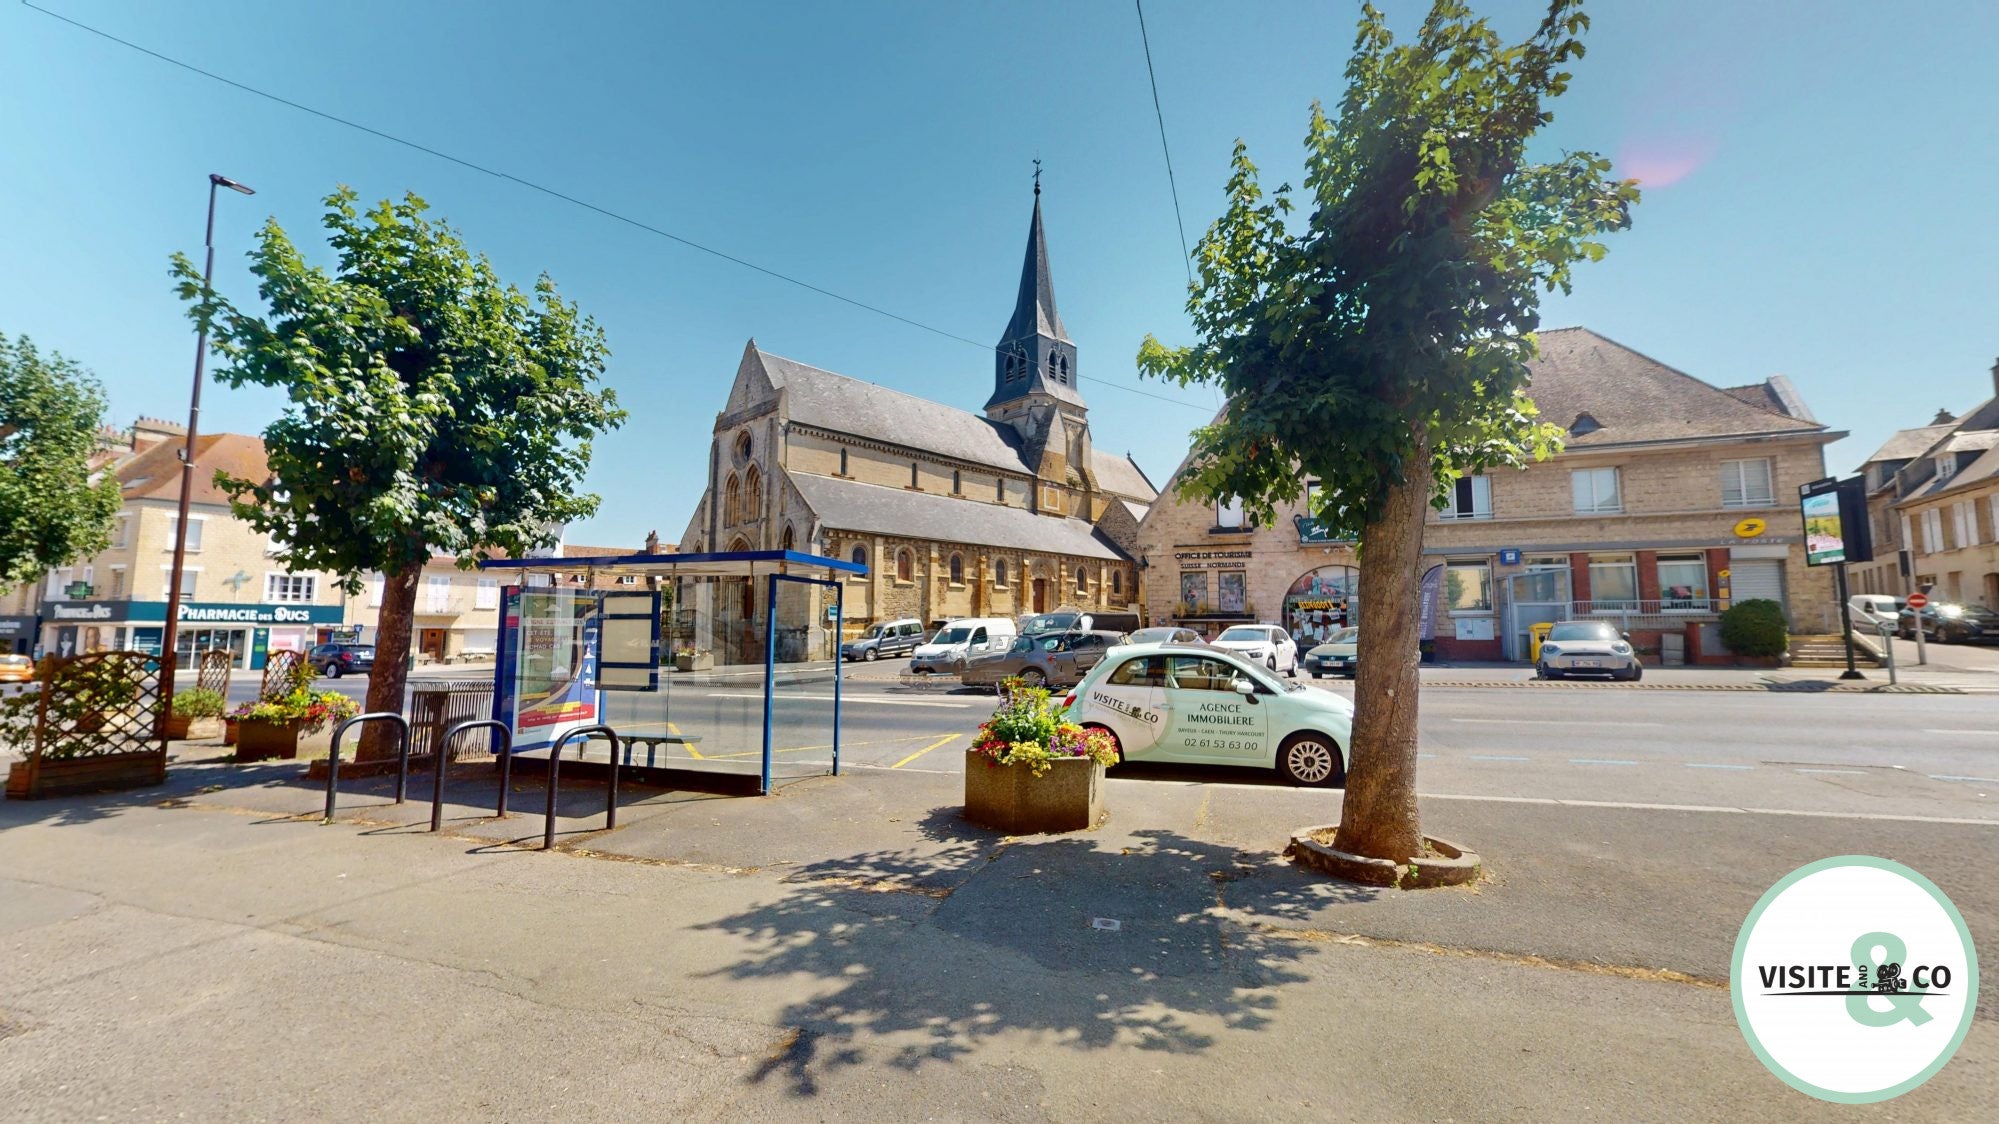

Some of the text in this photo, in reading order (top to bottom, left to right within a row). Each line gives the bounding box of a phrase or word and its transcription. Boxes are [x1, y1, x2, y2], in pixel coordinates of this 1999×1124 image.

[1175, 551, 1253, 560] OFFICE DE TOURISME
[1206, 561, 1246, 569] NORMANDE
[177, 604, 258, 621] PHARMACIE
[1093, 691, 1125, 711] VISITE
[1144, 711, 1159, 724] CO
[1199, 702, 1241, 714] AGENCE
[1187, 713, 1255, 726] IMMOBILIERE
[1237, 730, 1265, 738] HARCOURT
[1184, 738, 1258, 751] 02 61 53 63 00
